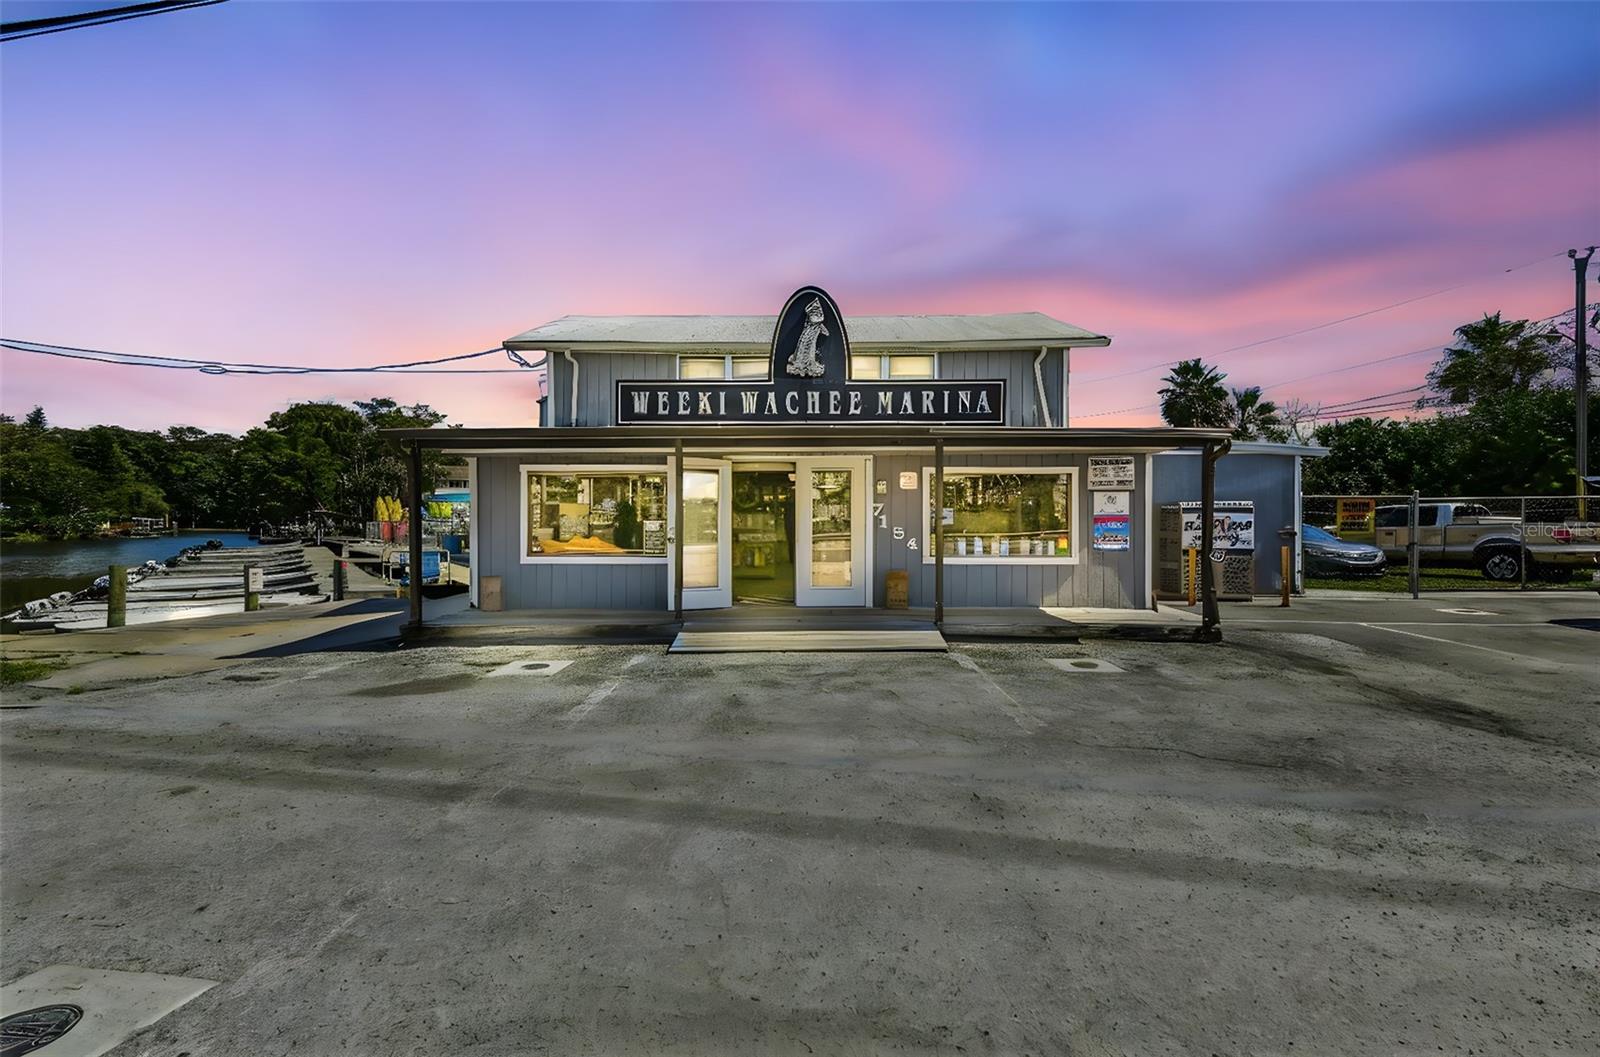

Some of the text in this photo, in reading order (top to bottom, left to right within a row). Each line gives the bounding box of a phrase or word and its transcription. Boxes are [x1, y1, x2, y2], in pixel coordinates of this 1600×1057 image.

[631, 390, 992, 415] WEEKI WACHEE MARINA
[872, 503, 918, 550] 7154
